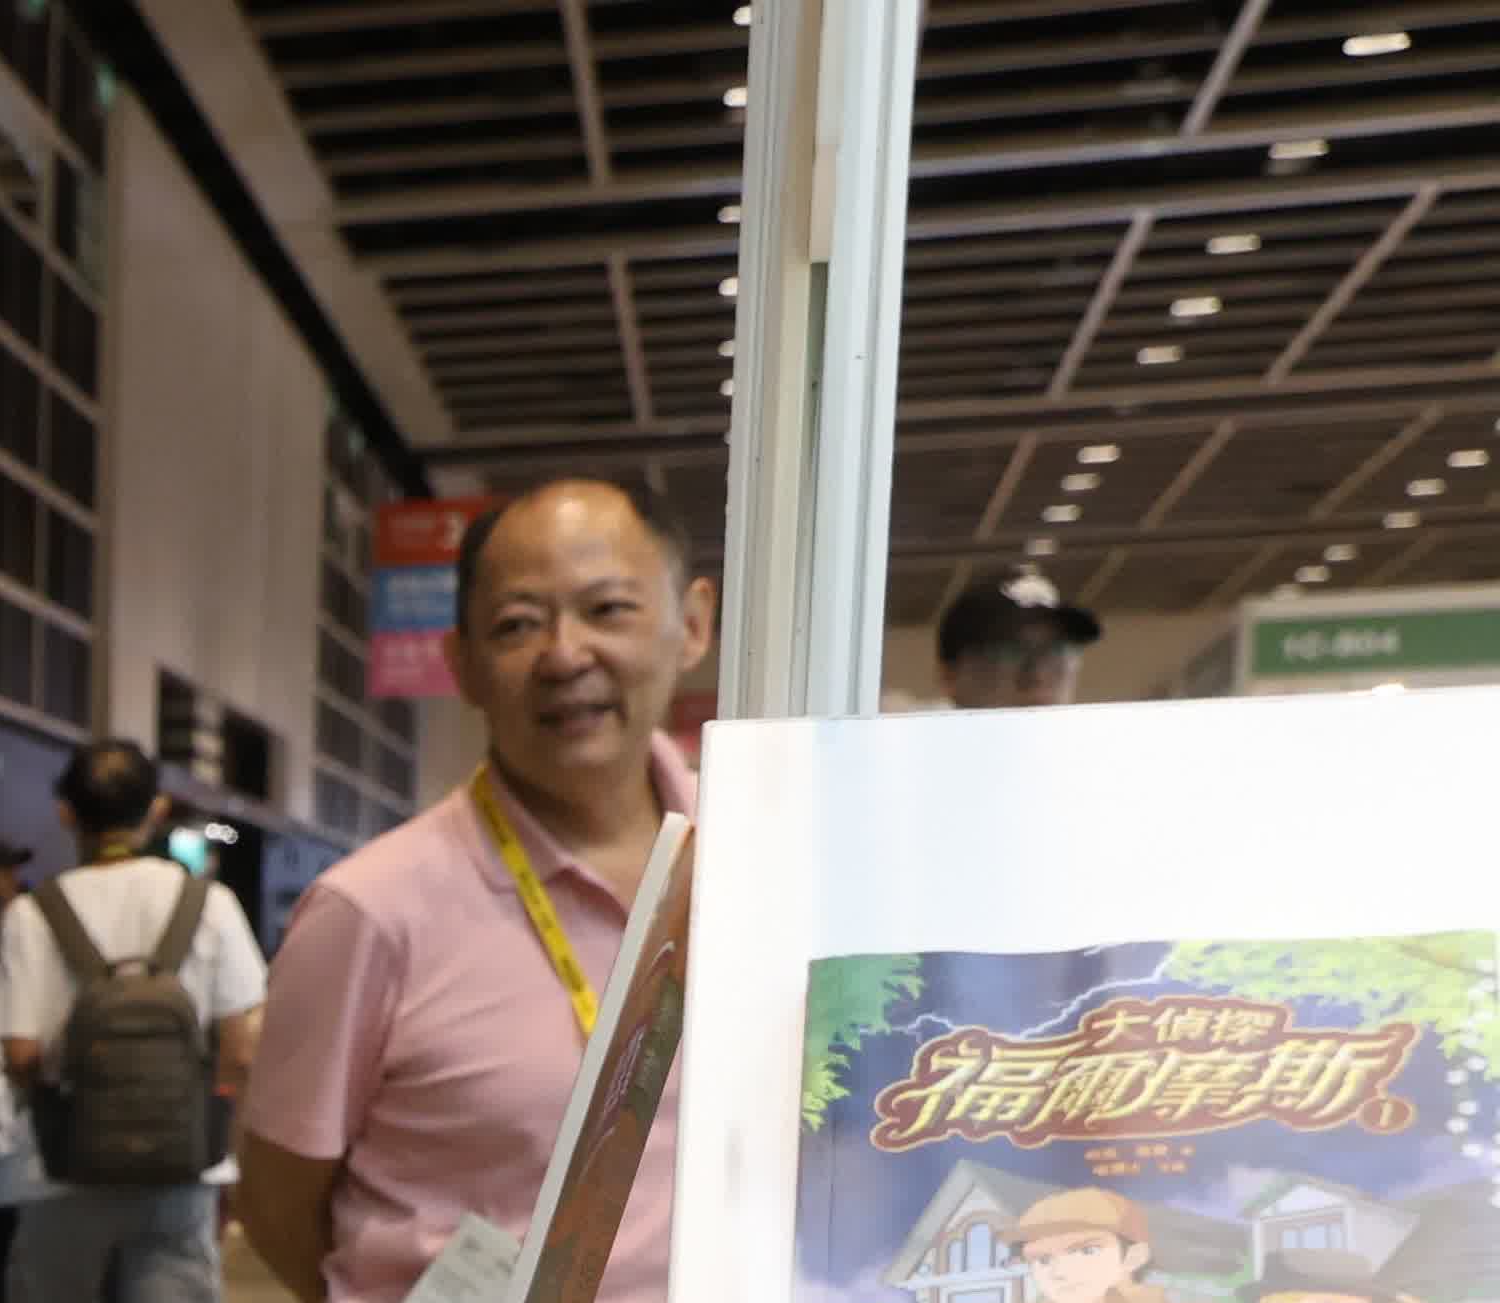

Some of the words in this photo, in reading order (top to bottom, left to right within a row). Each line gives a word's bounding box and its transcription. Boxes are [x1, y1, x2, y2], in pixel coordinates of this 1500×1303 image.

[1090, 1007, 1277, 1046] 大偵探
[894, 1036, 1405, 1140] 福爾摩斯
